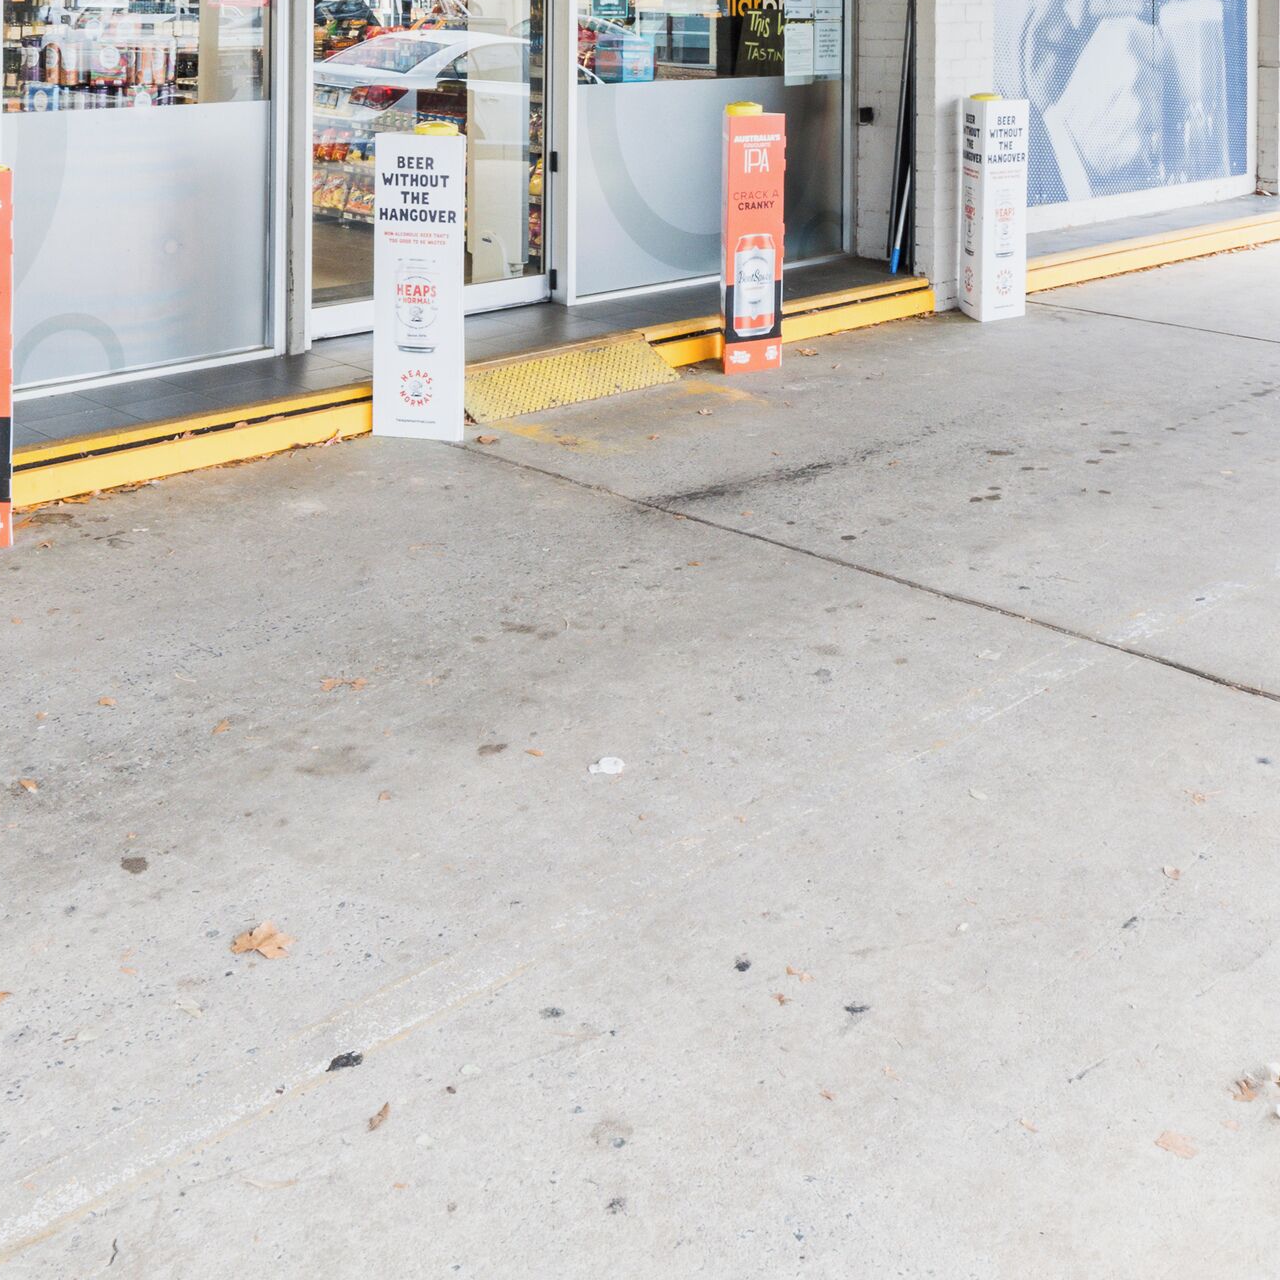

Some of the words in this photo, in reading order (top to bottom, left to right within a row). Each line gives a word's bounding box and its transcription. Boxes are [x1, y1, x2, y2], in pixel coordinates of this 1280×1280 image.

[747, 10, 770, 38] This
[744, 41, 784, 62] TASTIN
[997, 115, 1016, 126] BEER
[989, 128, 1023, 138] WITHOUT
[999, 141, 1013, 150] THE
[396, 156, 435, 170] BEER
[744, 148, 770, 174] IPA
[987, 152, 1026, 164] HANGOVER
[382, 172, 450, 188] WITHOUT
[400, 191, 430, 205] THE
[733, 190, 768, 201] CRACK
[772, 189, 779, 198] A
[738, 200, 775, 211] CRANKY
[378, 207, 457, 224] HANGOVER
[396, 283, 437, 298] HEAPS
[402, 296, 431, 305] NORMAL
[400, 369, 433, 385] HEAPS
[399, 390, 433, 407] NORMAL
